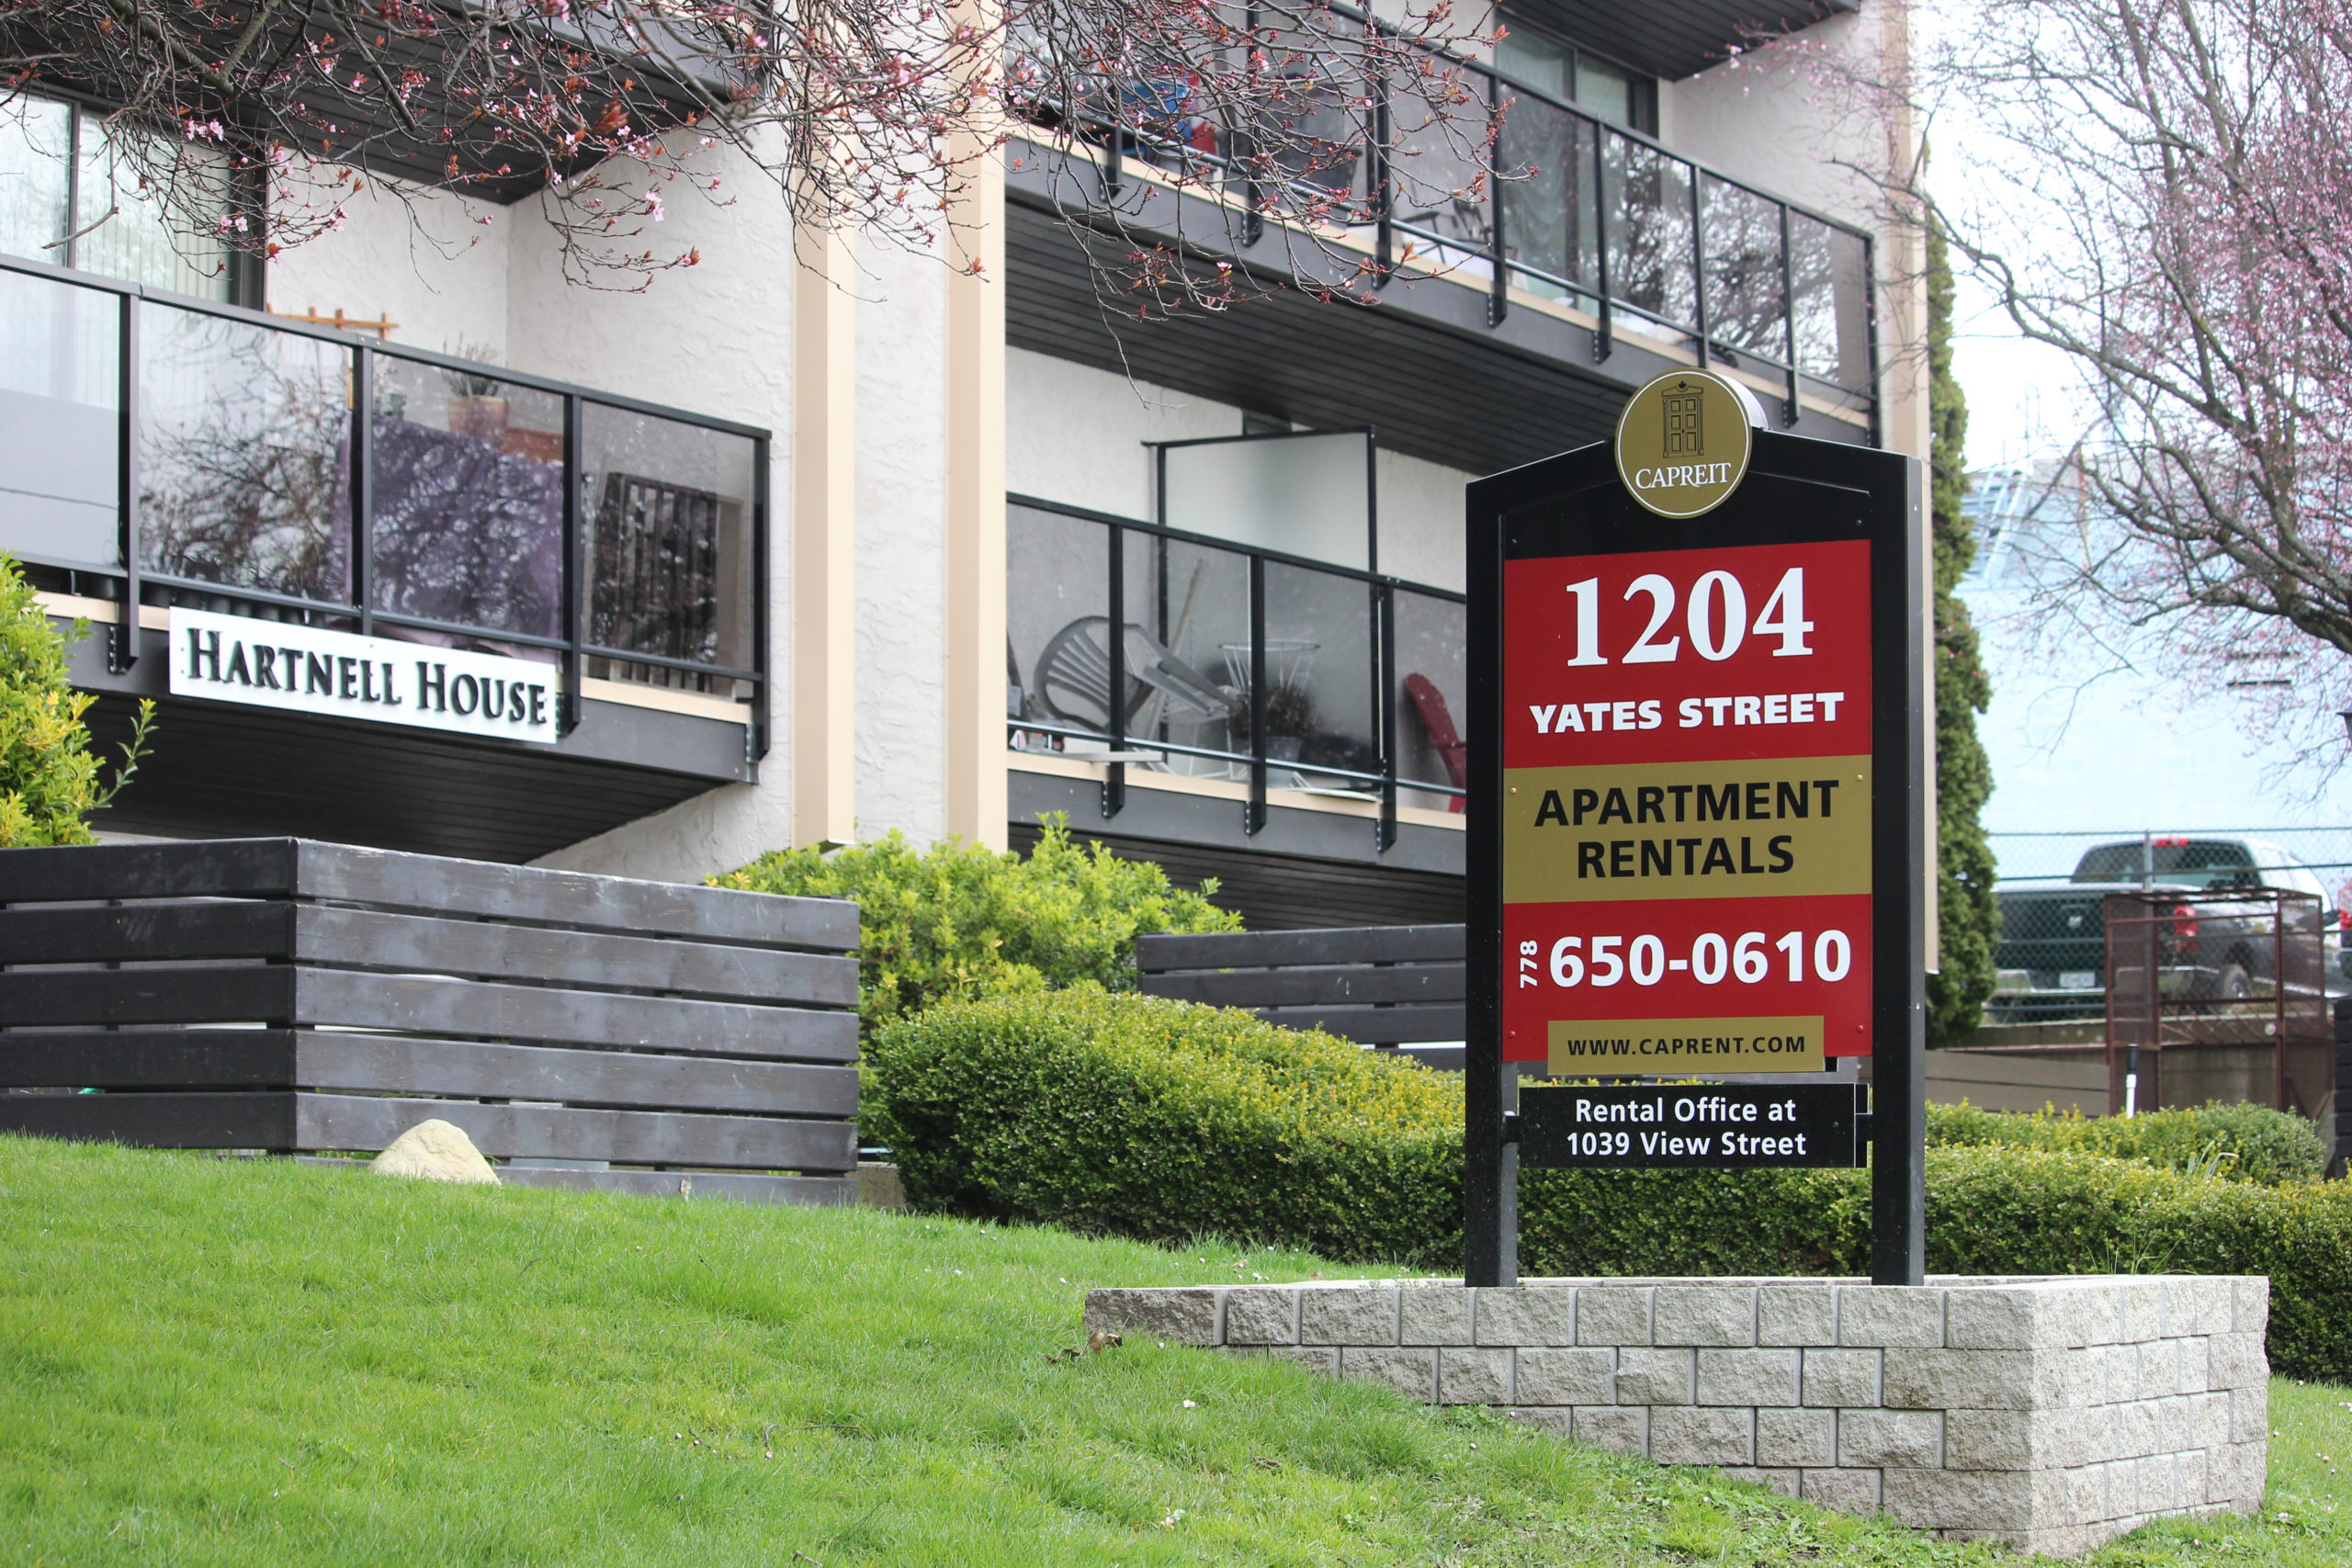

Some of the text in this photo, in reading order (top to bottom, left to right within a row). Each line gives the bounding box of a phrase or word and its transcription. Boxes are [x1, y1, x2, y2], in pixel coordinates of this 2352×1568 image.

[1634, 461, 1732, 491] CAPREIT
[1566, 567, 1815, 668] 1204
[187, 626, 548, 726] HARTNELL HOUSE
[1529, 692, 1845, 734] YATES STREET
[1534, 779, 1839, 828] APARTMENT
[1577, 835, 1794, 879] RENTALS
[1520, 940, 1538, 988] 778
[1549, 929, 1852, 988] 650-0610
[1567, 1035, 1805, 1056] WWW.CAPRENT.COM
[1575, 1097, 1796, 1122] Rental Office at
[1566, 1131, 1807, 1157] 1039 View Street
